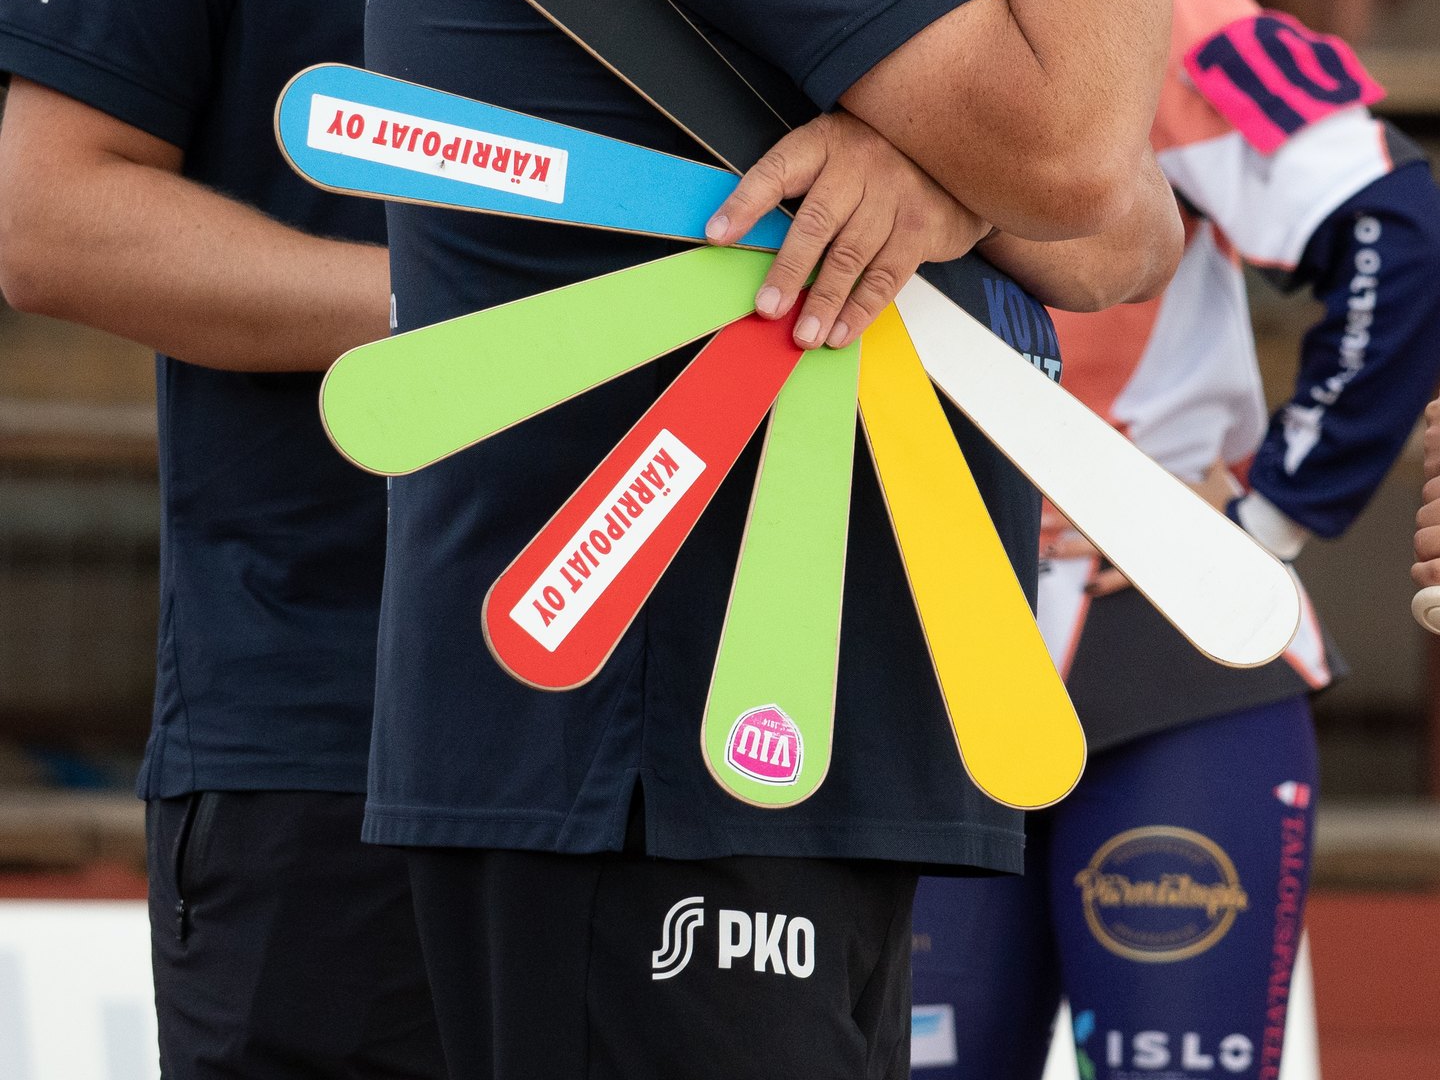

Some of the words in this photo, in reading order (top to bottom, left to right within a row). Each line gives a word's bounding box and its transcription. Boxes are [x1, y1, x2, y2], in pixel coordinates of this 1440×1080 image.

[1196, 16, 1361, 136] 10
[326, 109, 365, 139] OY
[372, 119, 551, 184] KÄRRIPOJAT
[559, 447, 680, 594] KÄRRIPOJAT
[532, 585, 566, 628] OY
[718, 909, 816, 979] PKO
[1106, 1029, 1255, 1072] ISLO
